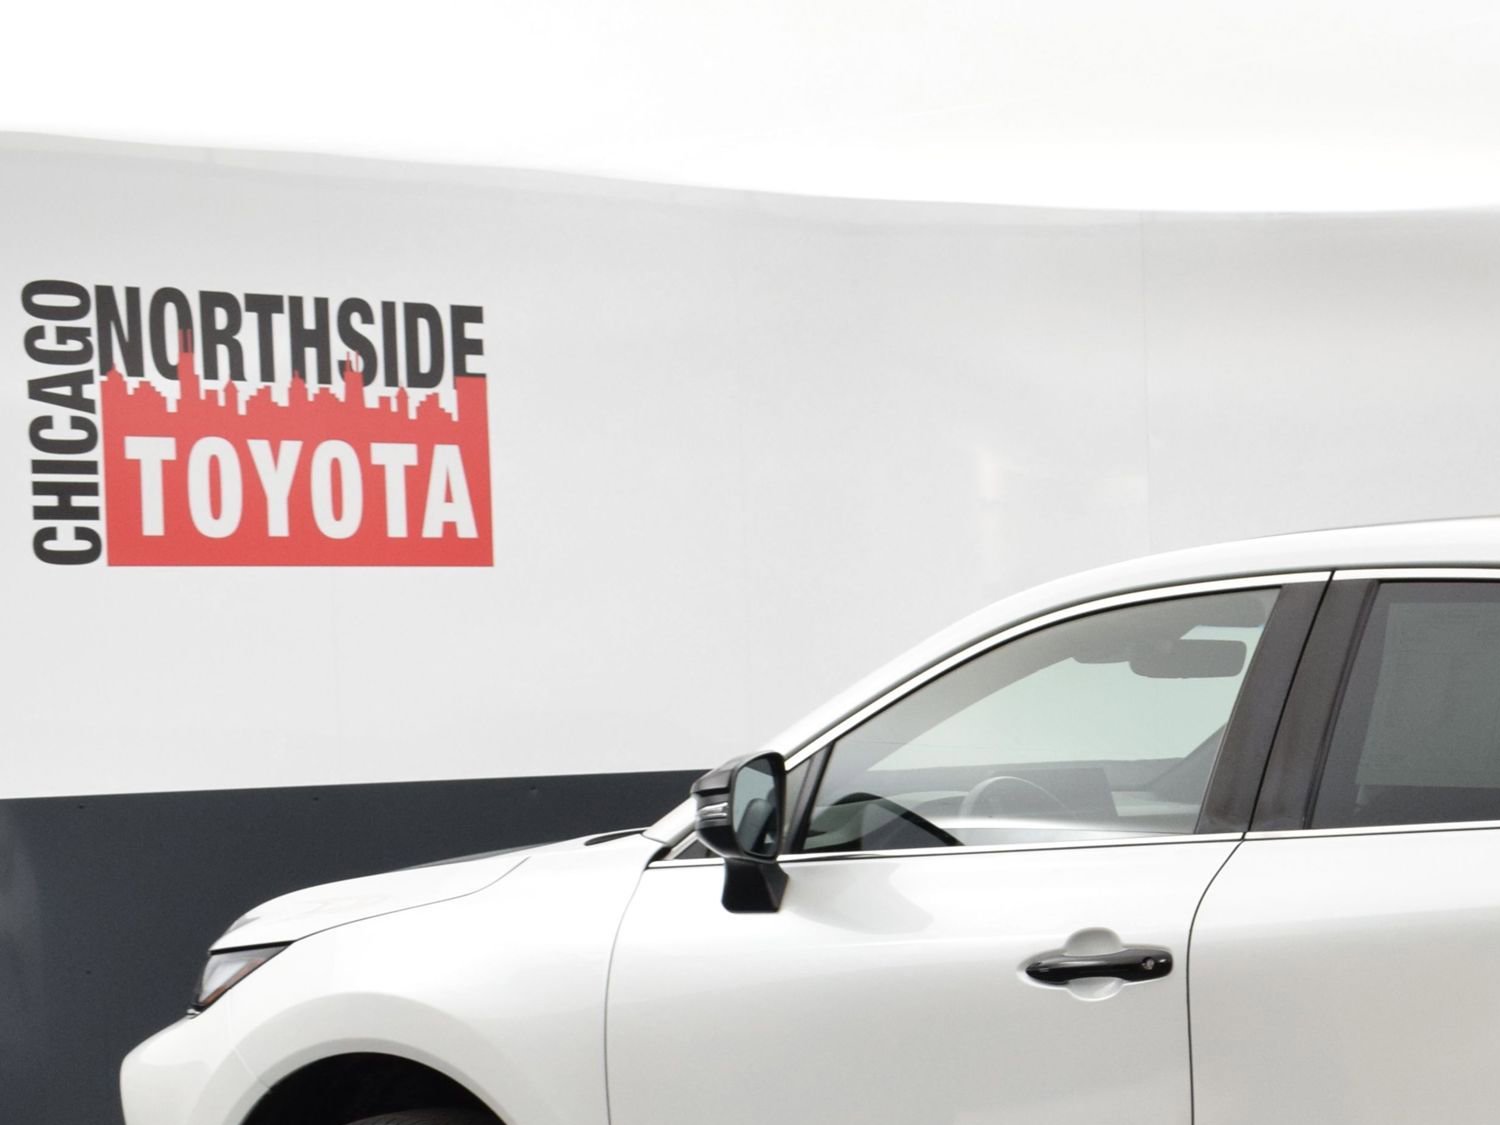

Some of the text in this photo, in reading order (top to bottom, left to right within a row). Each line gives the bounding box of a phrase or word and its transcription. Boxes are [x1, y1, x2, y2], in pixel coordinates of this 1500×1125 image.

[94, 284, 487, 389] NORTHSIDE
[20, 279, 103, 566] CHICAGO
[124, 436, 479, 540] TOYOTA
